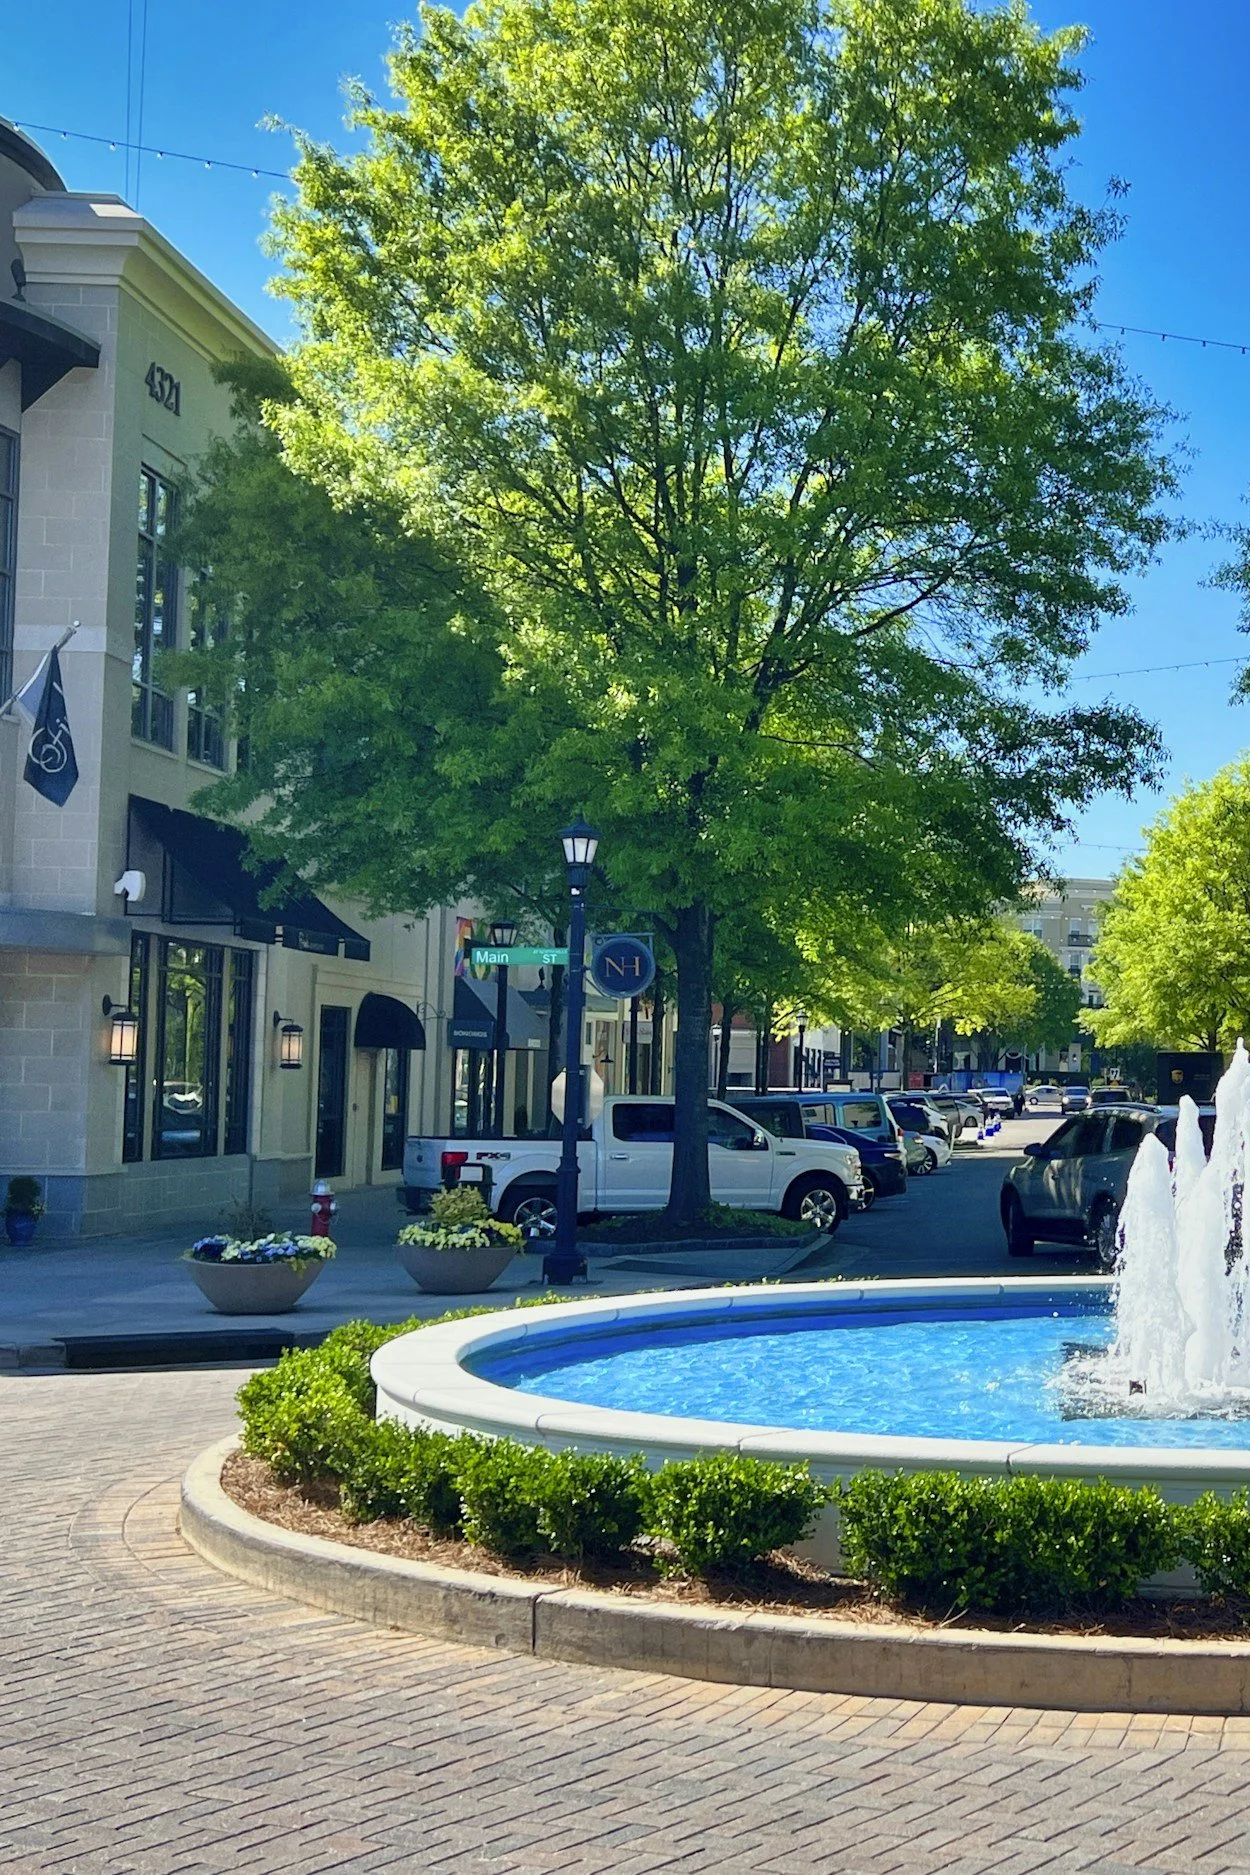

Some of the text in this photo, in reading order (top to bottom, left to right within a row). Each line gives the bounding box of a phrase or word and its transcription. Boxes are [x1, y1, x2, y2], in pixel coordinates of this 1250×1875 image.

[144, 361, 181, 417] 4321
[476, 950, 558, 964] Main ST
[604, 956, 641, 977] NH
